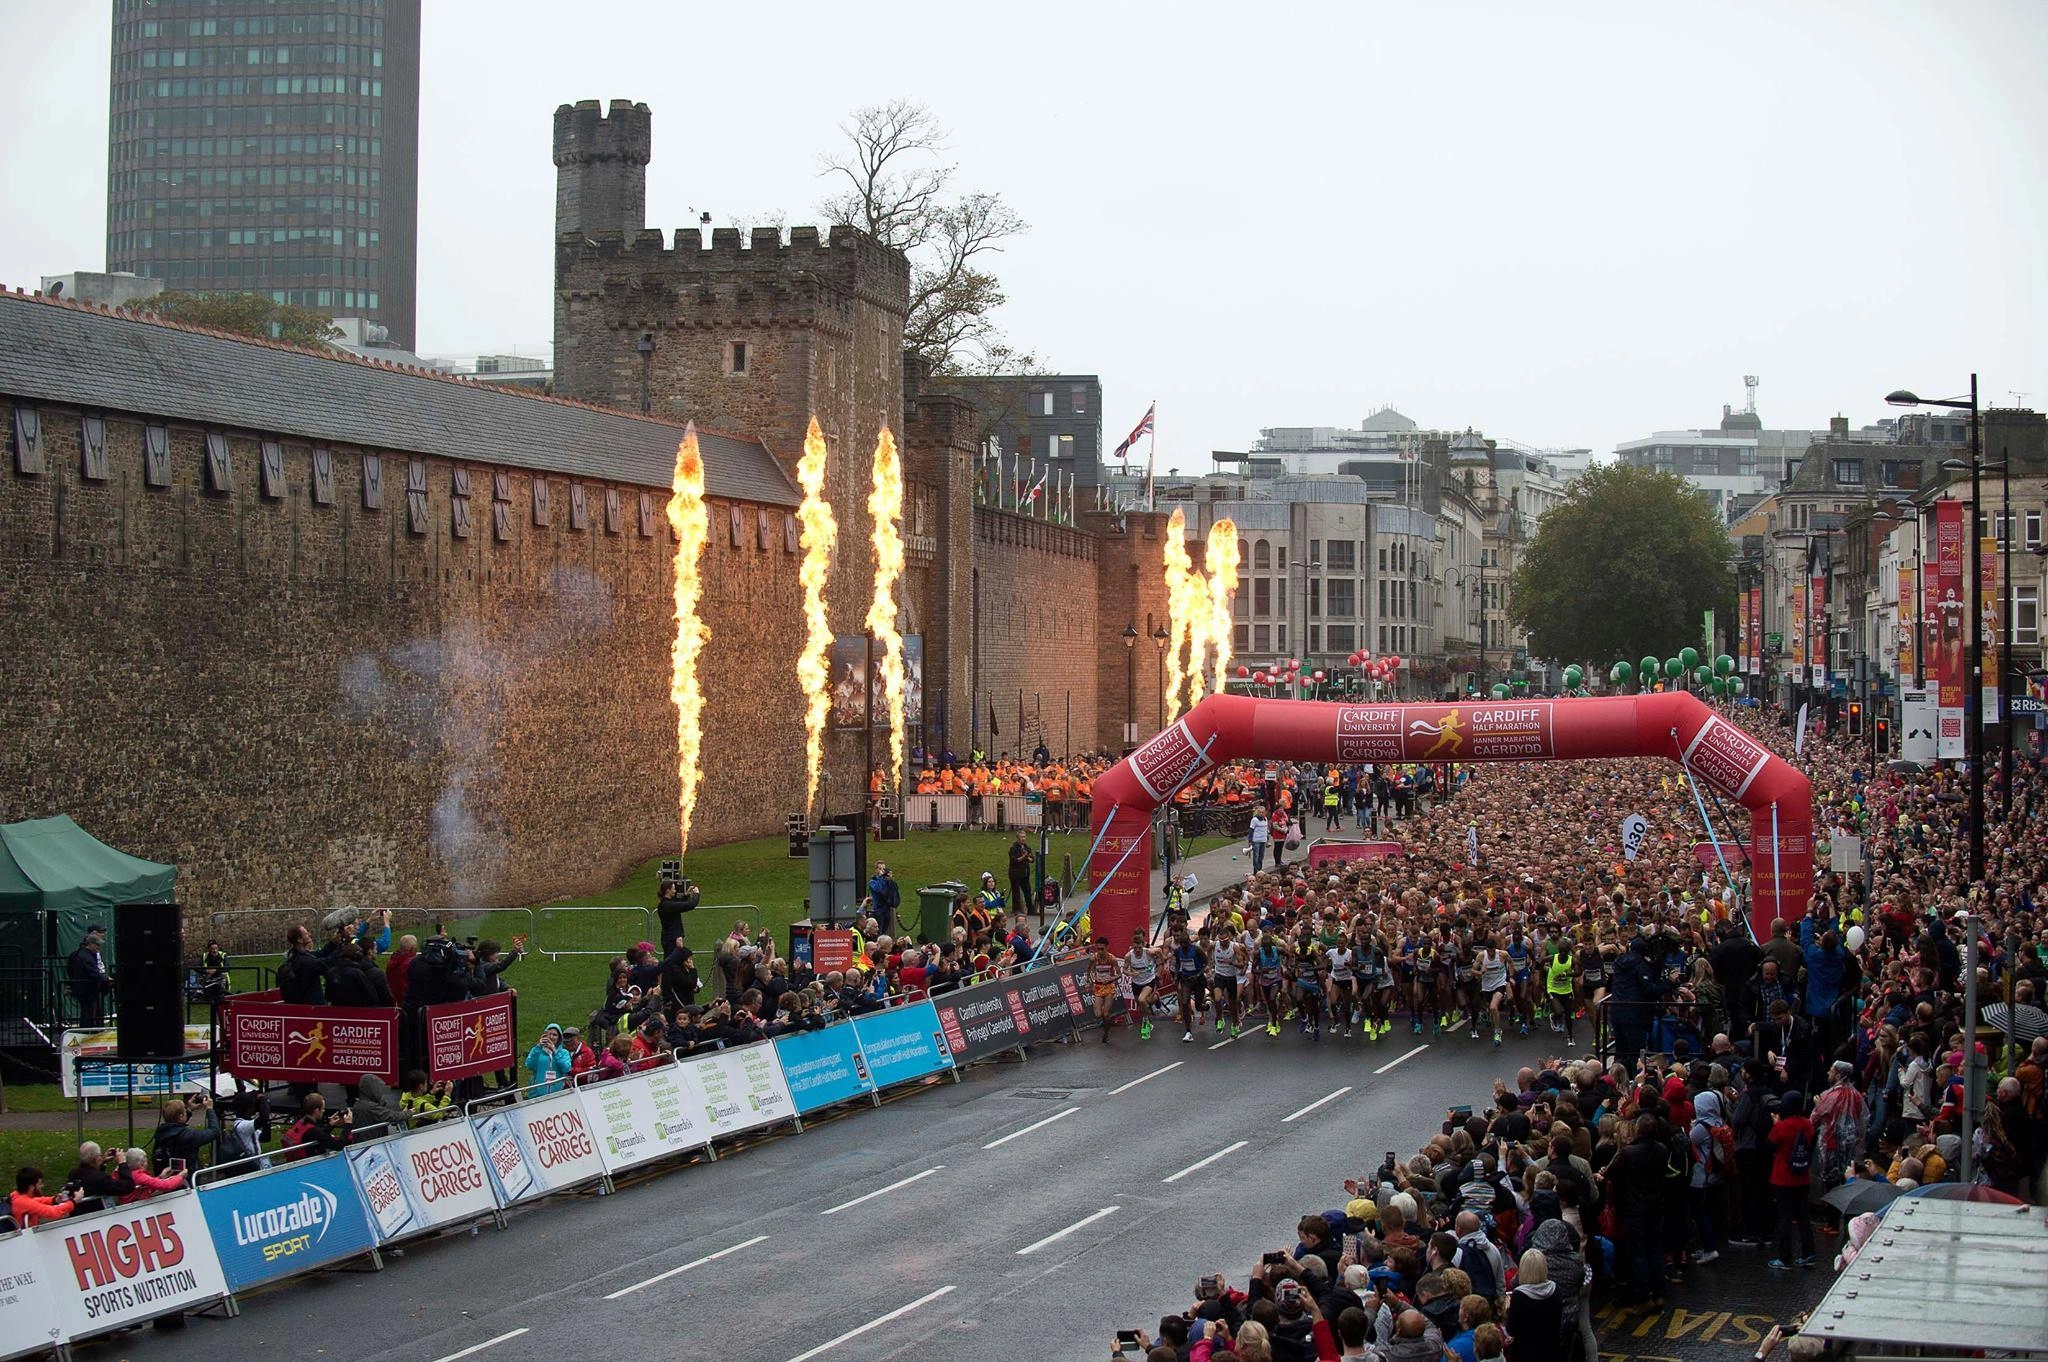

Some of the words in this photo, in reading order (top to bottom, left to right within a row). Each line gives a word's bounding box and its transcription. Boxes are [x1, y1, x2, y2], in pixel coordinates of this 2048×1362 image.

[1343, 710, 1400, 724] CARDIFF
[1472, 709, 1541, 723] CARDIFF
[1344, 723, 1397, 731] UNIVERSITY
[1472, 723, 1494, 732] HALF
[1495, 722, 1541, 731] MARATHON
[1138, 727, 1181, 764] CARDIFF
[1343, 739, 1397, 748] PRIFYSGOL
[1473, 736, 1501, 744] HANNER
[1503, 735, 1541, 743] MARATHON
[1473, 743, 1542, 756] CAERDYDD
[1713, 725, 1761, 760] CARDIFF
[1143, 739, 1184, 771] UNIVERSITY
[1708, 734, 1752, 767] UNIVERSITY
[1151, 751, 1194, 783] PRIFYSGOL
[1700, 747, 1741, 780] PRIFYSGOL
[1624, 821, 1646, 852] 1:30
[1021, 987, 1039, 1004] Cardiff
[1037, 982, 1060, 999] University
[958, 1002, 978, 1021] Cardiff
[976, 996, 1004, 1016] University
[240, 1018, 281, 1032] CARDIFF
[435, 1018, 461, 1033] CARDIFF
[485, 1012, 507, 1027] CARDIFF
[987, 1015, 1014, 1036] Caerdydd
[241, 1032, 280, 1040] UNIVERSITY
[332, 1025, 381, 1039] CARDIFF
[332, 1037, 348, 1045] HALF
[349, 1038, 382, 1046] MARATHON
[436, 1031, 460, 1041] UNIVERSITY
[241, 1044, 279, 1053] PRIFYSGOL
[486, 1040, 508, 1054] CAERDYDD
[333, 1055, 382, 1067] CAERDYDD
[755, 1091, 784, 1107] Barnardo's
[712, 1102, 741, 1119] Barnardo's
[528, 1109, 584, 1146] BRECON
[662, 1118, 694, 1136] Barnardo's
[538, 1132, 593, 1169] CARREG
[614, 1131, 647, 1150] Barnardo's
[411, 1138, 474, 1179] BRECON
[491, 1139, 517, 1167] BRECON
[497, 1149, 522, 1179] CARREG
[367, 1169, 396, 1201] BRECON
[420, 1164, 483, 1203] CARREG
[373, 1183, 402, 1215] CARREG
[232, 1192, 324, 1246] Lucozade
[64, 1211, 184, 1292] HIGH5
[262, 1234, 311, 1262] SPORT
[84, 1286, 134, 1319] SPORTS
[134, 1268, 198, 1305] NUTRITION
